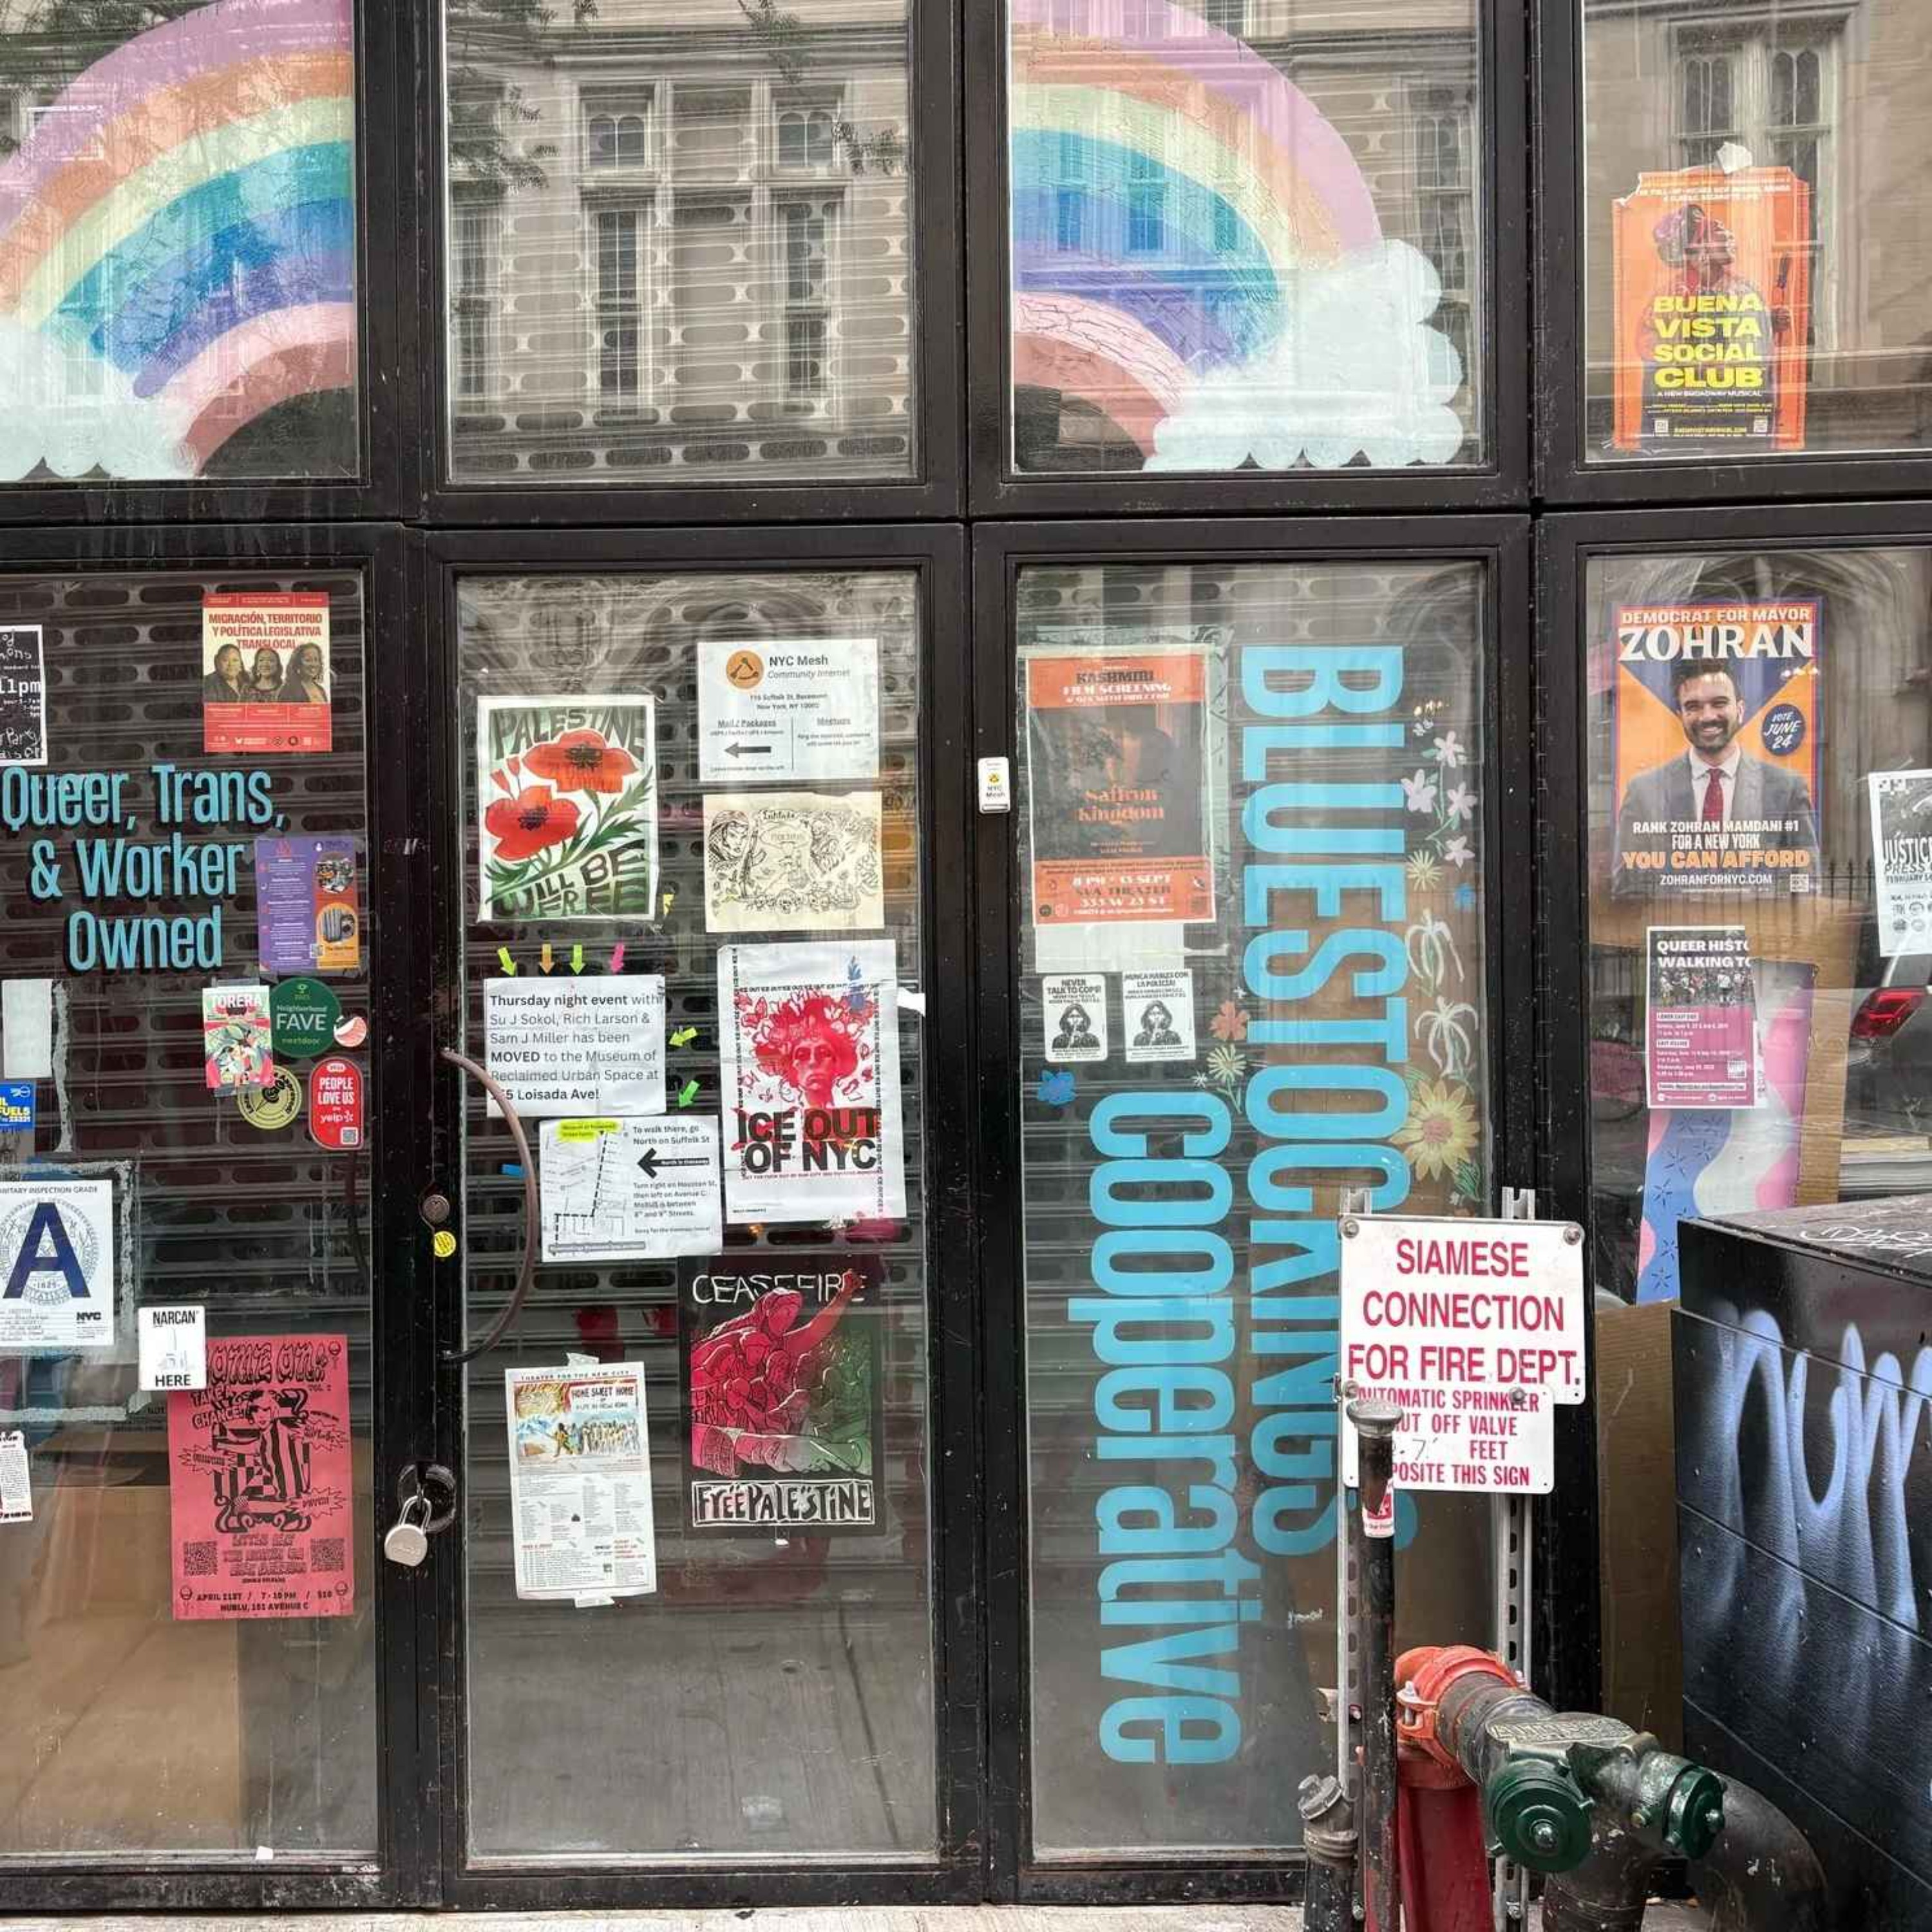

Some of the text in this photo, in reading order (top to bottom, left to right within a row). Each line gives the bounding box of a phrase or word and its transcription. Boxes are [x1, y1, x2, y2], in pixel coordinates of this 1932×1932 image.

[1654, 294, 1762, 312] BUENA
[1654, 317, 1761, 338] VISTA
[1654, 343, 1761, 363] SOCIAL
[1654, 367, 1763, 388] CLUB
[209, 611, 322, 625] MIGRACIÓN, TERRITORIO
[1622, 608, 1810, 625] DEMOCRAT FOR MAYOR
[212, 627, 220, 636] Y
[264, 626, 321, 636] LEGISLATIVA
[1618, 623, 1815, 661] ZOHRAN
[769, 654, 828, 667] NYC Mesh
[768, 668, 851, 679] Community Internet
[1076, 670, 1153, 684] KASHMIRI
[1772, 710, 1794, 724] VOTE
[1762, 721, 1801, 737] JUNE
[1772, 735, 1792, 750] 24
[1, 764, 285, 831] Queer, Trans,
[1633, 820, 1799, 834] RANK ZOHRAN MAMDANI #1
[1672, 833, 1760, 850] FOR A NEW YORK
[30, 833, 245, 898] & Worker
[1621, 849, 1810, 869] YOU CAN AFFORD
[1884, 863, 1926, 874] PRESS
[1660, 874, 1772, 886] ZOHRANFORNYC.COM
[68, 904, 223, 967] Owned
[1657, 940, 1706, 955] QUEER
[1657, 956, 1734, 968] WALKING
[1048, 987, 1067, 995] TALK
[490, 993, 659, 1009] Thursday night event with
[276, 1013, 327, 1031] FAVE
[490, 1012, 650, 1027] Su J Sokol, Rich Larson &
[490, 1031, 630, 1044] Sam J Miller has been
[491, 1050, 657, 1063] MOVED to the Museum of
[491, 1069, 659, 1082] Reclaimed Urban Space at
[319, 1077, 353, 1090] PEOPLE
[317, 1092, 354, 1105] LOVE US
[518, 1089, 567, 1100] Loisada
[571, 1088, 600, 1100] Ave!
[320, 1113, 344, 1123] yelp
[664, 1126, 687, 1134] there,
[737, 1108, 878, 1144] ICE OUT
[671, 1136, 699, 1144] Suffolk
[745, 1139, 878, 1174] OF NYC
[2, 1202, 91, 1299] A
[1396, 1238, 1530, 1278] SIAMESE
[76, 1312, 102, 1321] NYC
[153, 1310, 196, 1326] NARCAN
[1363, 1290, 1564, 1332] CONNECTION
[1347, 1343, 1580, 1386] FOR FIRE DEPT.
[155, 1374, 191, 1387] HERE
[571, 1386, 635, 1398] HOME SWEET HOME
[1067, 1091, 1262, 1765] cooperative
[1396, 1413, 1517, 1436] UT OFF VALVE
[1469, 1440, 1508, 1460] FEET
[1392, 1462, 1530, 1486] POSITE THIS SIGN
